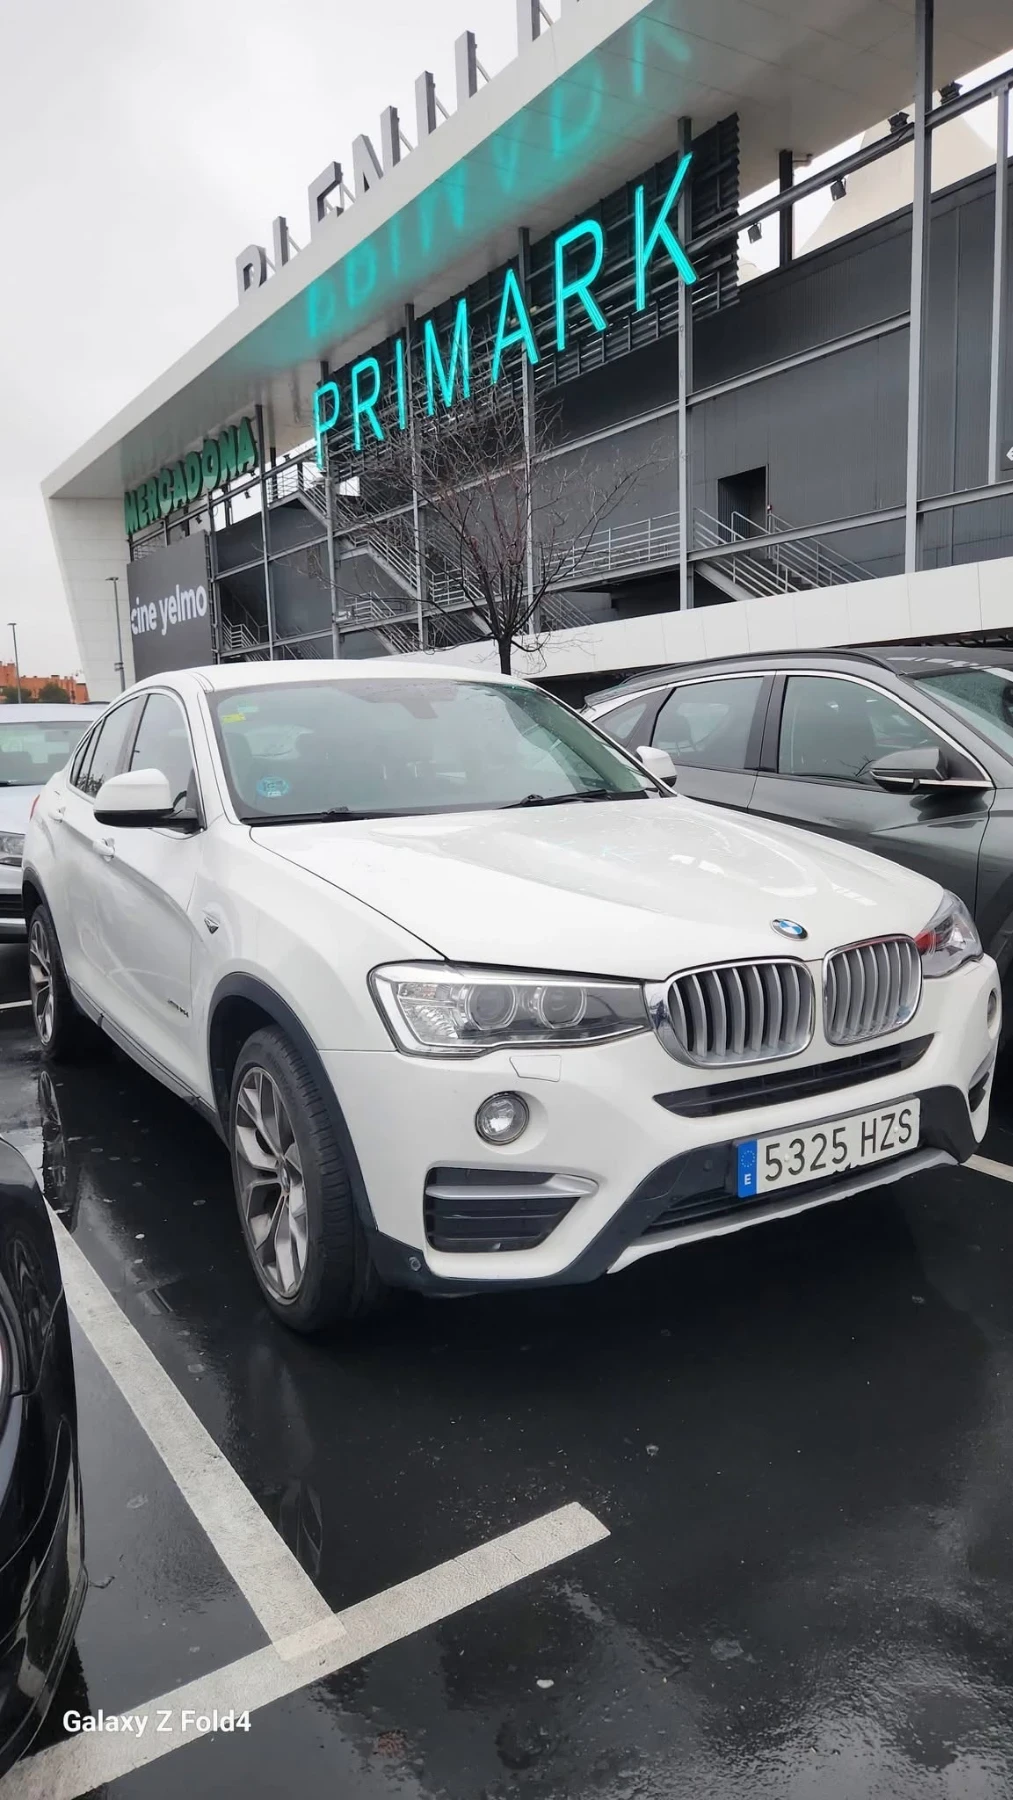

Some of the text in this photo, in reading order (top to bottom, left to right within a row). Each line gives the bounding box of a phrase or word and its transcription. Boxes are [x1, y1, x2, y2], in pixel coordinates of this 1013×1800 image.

[313, 151, 698, 470] PRIMARK
[124, 416, 259, 535] MERCADONA
[131, 584, 208, 636] cine yelmo
[744, 1173, 752, 1186] E
[765, 1108, 912, 1182] 5325 HZS
